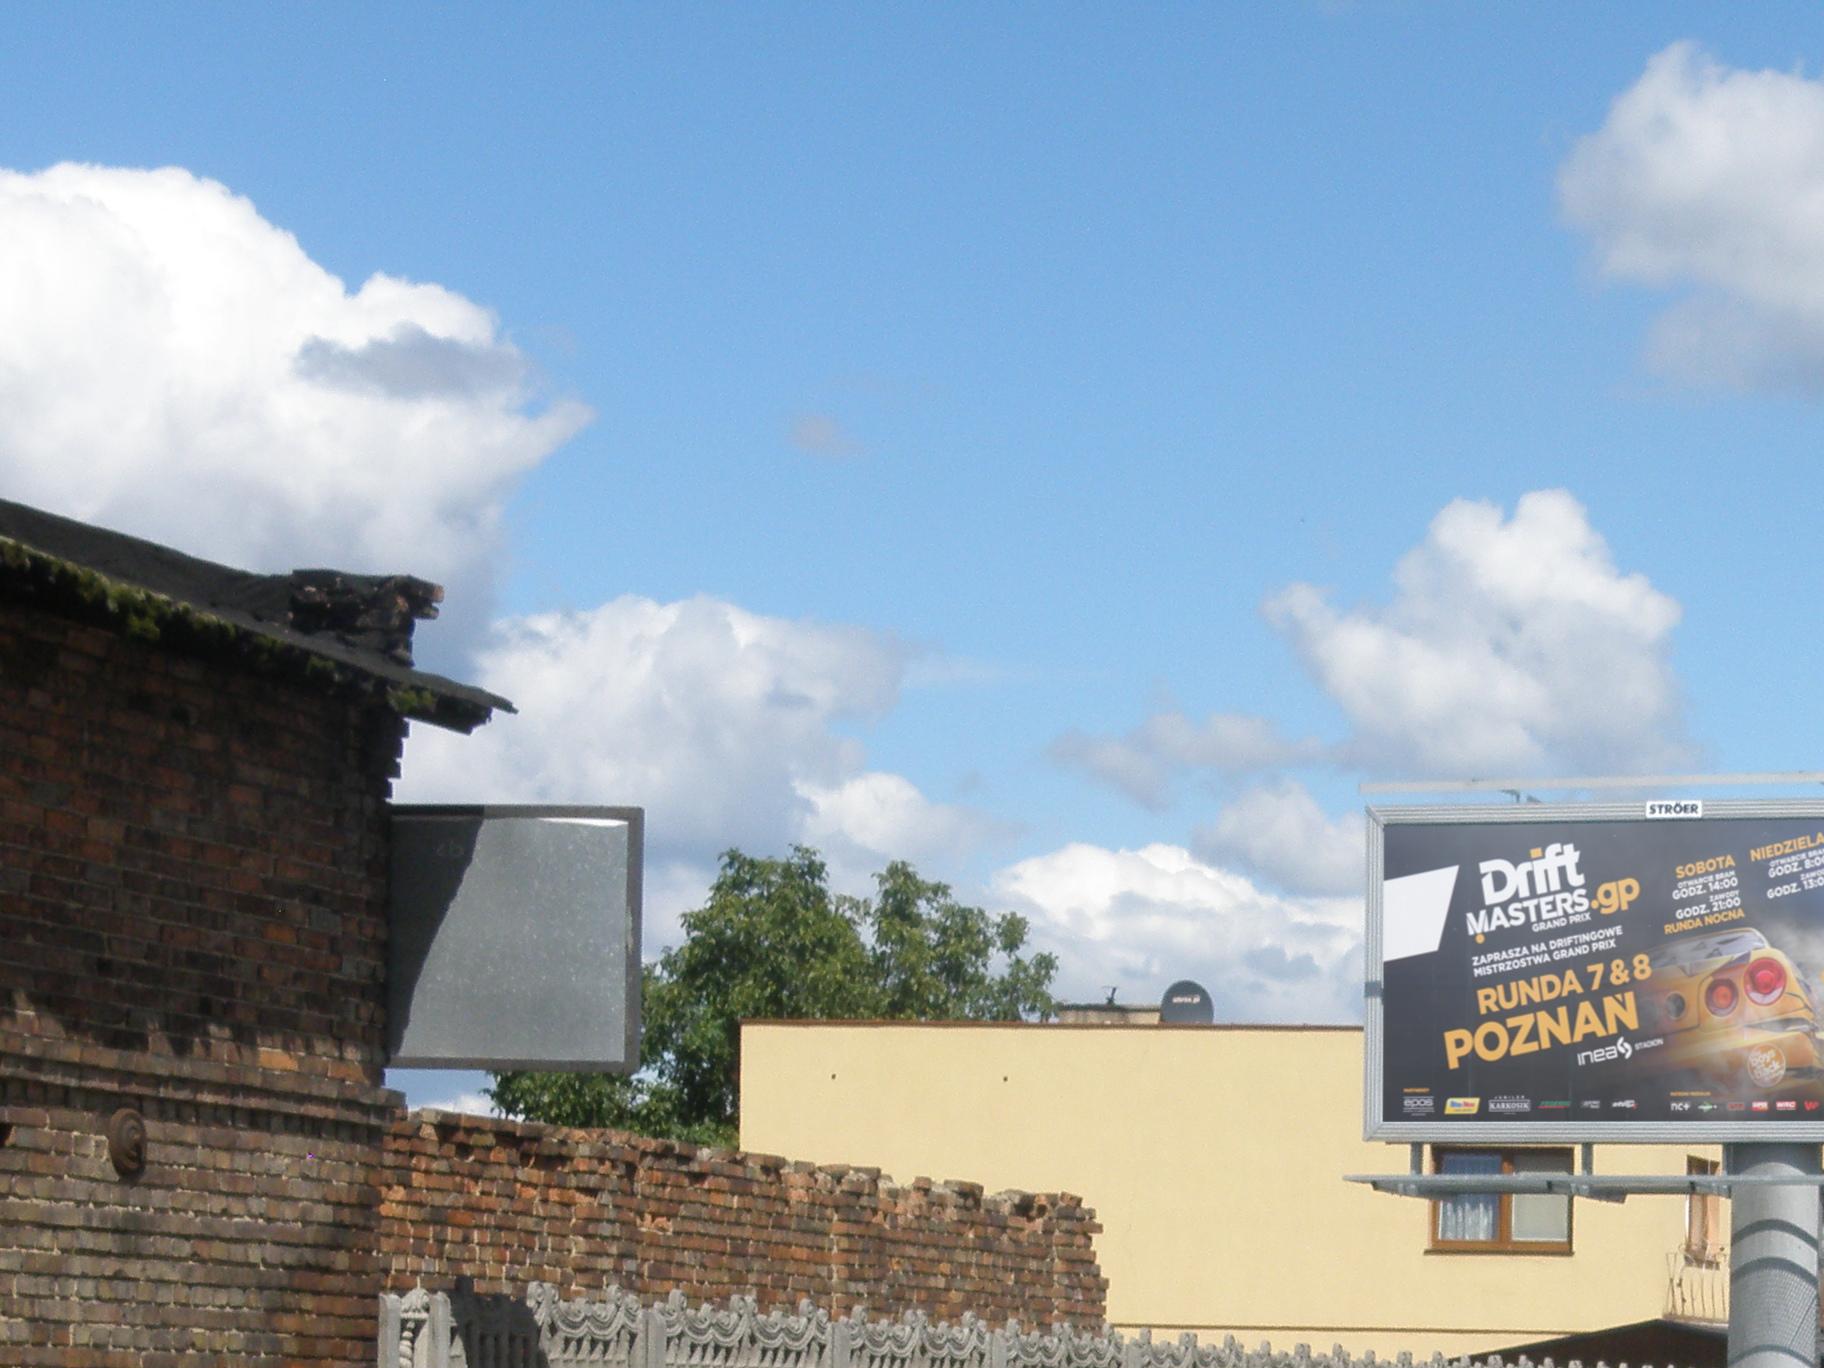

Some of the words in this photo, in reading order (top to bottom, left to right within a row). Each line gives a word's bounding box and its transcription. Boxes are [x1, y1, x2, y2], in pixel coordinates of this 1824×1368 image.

[1650, 802, 1699, 815] STRÖER
[1479, 843, 1585, 906] Drift
[1675, 855, 1735, 879] SOBOTA
[1768, 865, 1803, 878] GODZ.
[1672, 886, 1706, 900] GODZ.
[1708, 877, 1738, 891] 14:00
[1766, 885, 1802, 899] GODZ.
[1675, 904, 1710, 920] GODZ.
[1712, 897, 1741, 912] 21:00
[1532, 917, 1567, 932] GRAND
[1569, 912, 1592, 926] PRIX
[1664, 918, 1703, 935] RUNDA
[1704, 908, 1745, 926] NOCNA
[1472, 946, 1530, 966] ZAPRASZA
[1531, 942, 1548, 955] NA
[1549, 925, 1623, 950] DRIFTINGOWE
[1473, 954, 1551, 978] MISTRZOSTWA
[1553, 945, 1589, 961] GRAND
[1592, 938, 1616, 953] PRIX
[1476, 969, 1584, 1015] RUNDA
[1587, 963, 1604, 991] 7
[1609, 959, 1630, 986] &
[1632, 953, 1653, 981] 8
[1671, 1102, 1691, 1112] nc+
